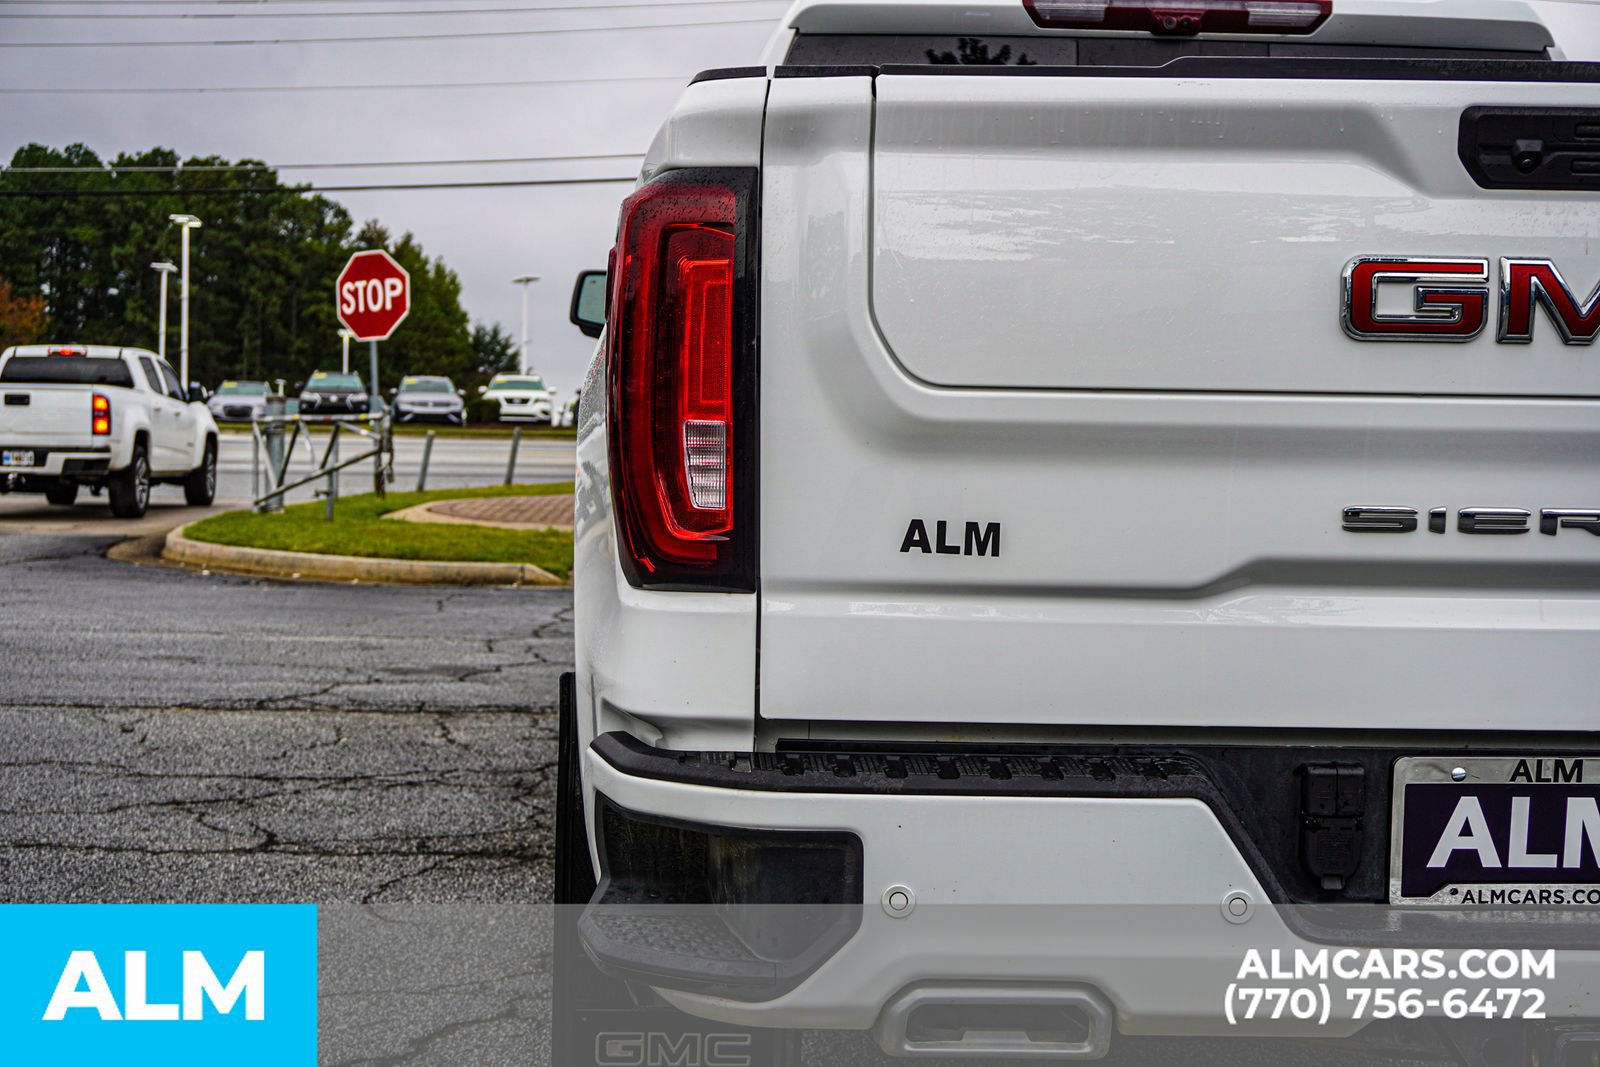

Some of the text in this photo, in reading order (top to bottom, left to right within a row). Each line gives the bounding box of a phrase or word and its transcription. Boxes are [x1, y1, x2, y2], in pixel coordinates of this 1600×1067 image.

[342, 278, 403, 315] STOP
[1340, 254, 1600, 345] GM
[1342, 505, 1600, 536] SIER
[900, 519, 1000, 557] ALM
[1509, 759, 1584, 783] ALM
[1461, 889, 1600, 905] ALMCARS.CO
[595, 1032, 752, 1066] GMC
